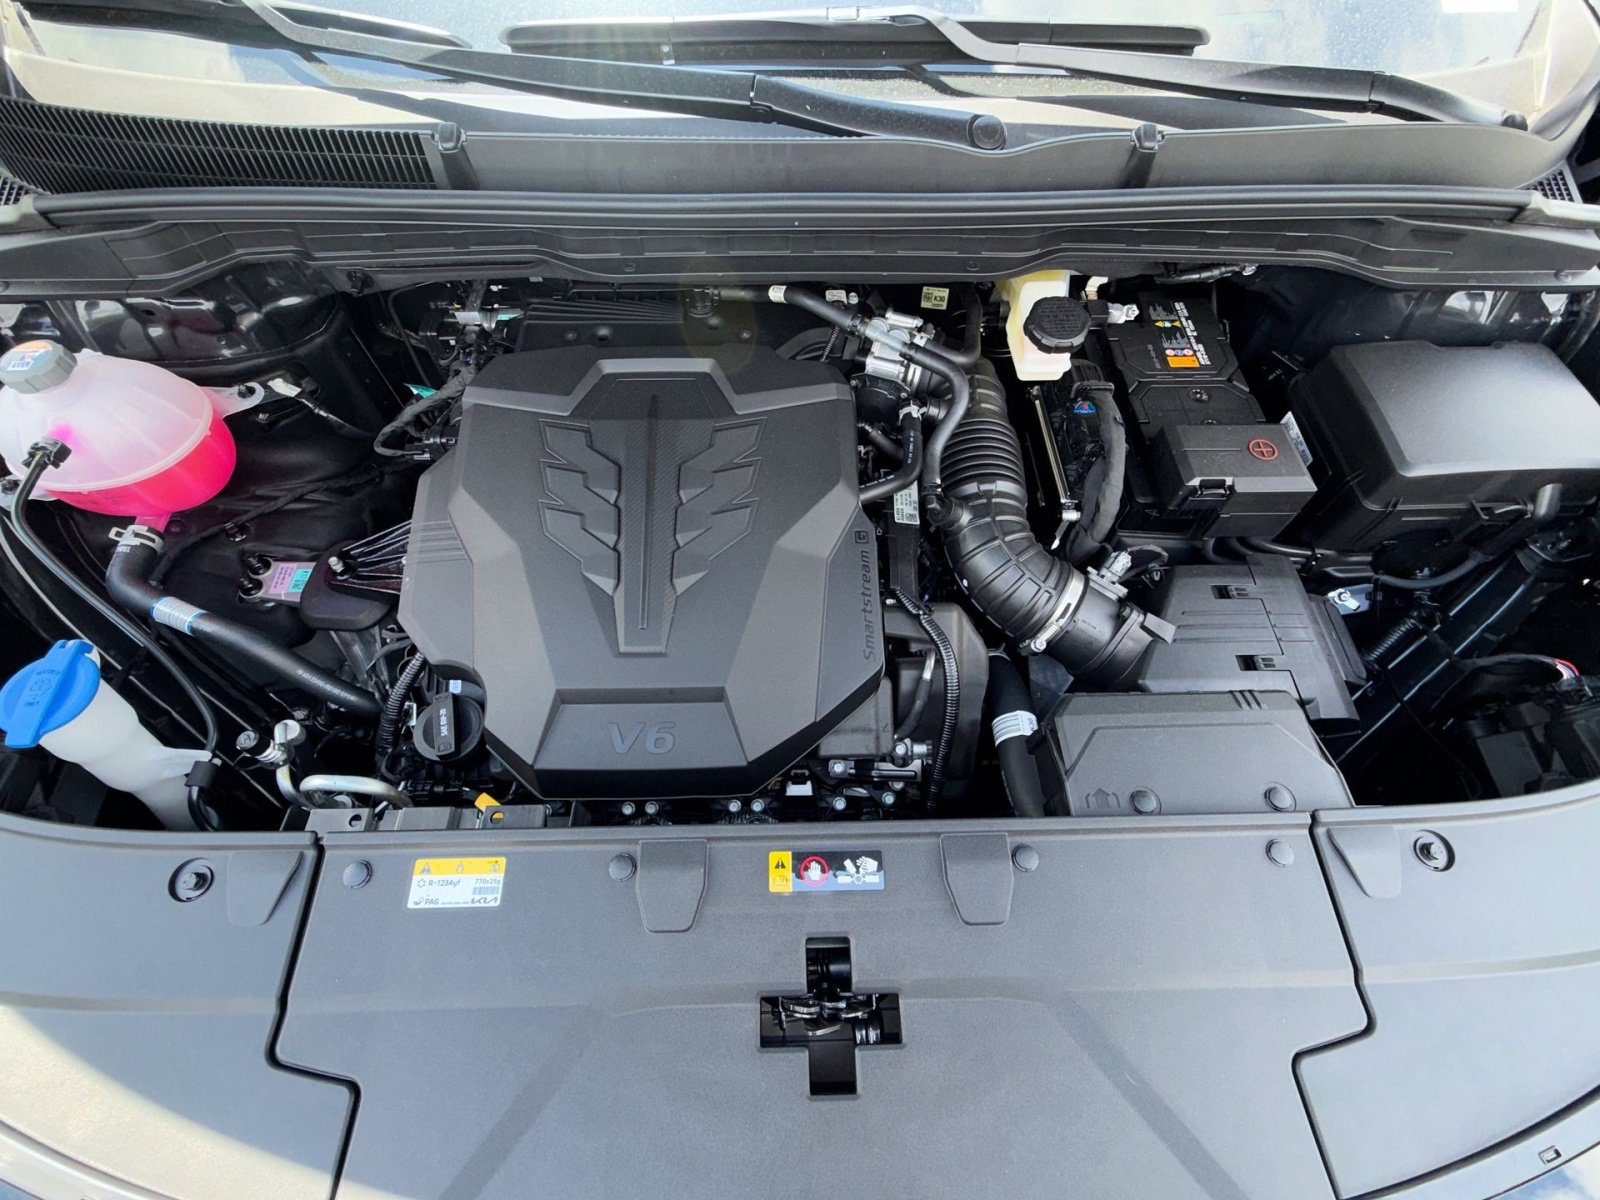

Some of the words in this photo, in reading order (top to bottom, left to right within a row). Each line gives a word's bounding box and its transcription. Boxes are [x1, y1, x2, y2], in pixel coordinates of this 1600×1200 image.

[860, 550, 876, 660] Smartstream
[608, 721, 677, 755] V6
[428, 878, 461, 888] R-1234yf
[424, 897, 440, 906] PAG
